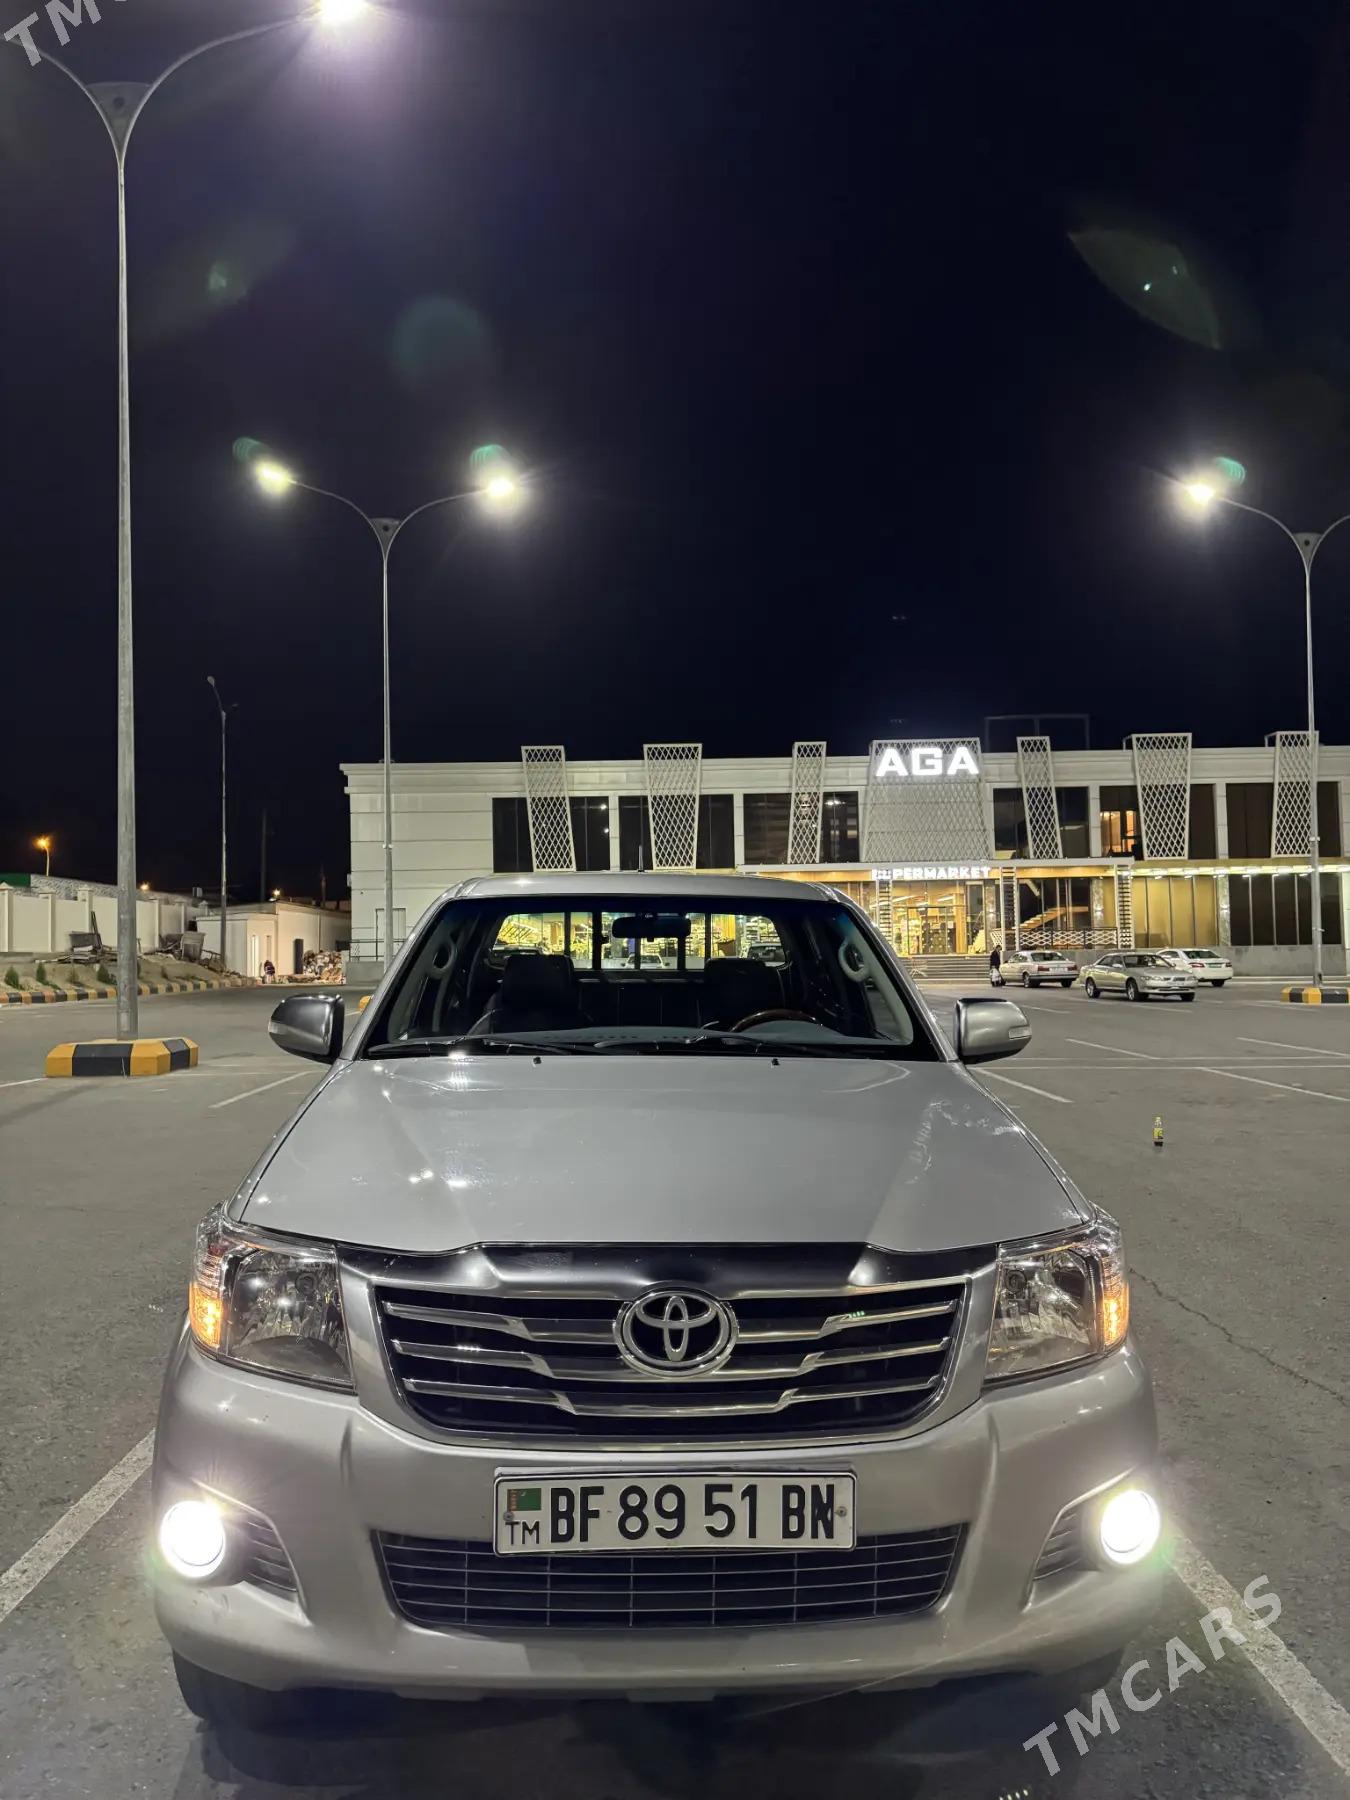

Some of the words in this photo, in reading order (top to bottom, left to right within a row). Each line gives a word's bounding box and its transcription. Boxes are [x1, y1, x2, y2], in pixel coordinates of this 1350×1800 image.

[876, 747, 980, 777] AGA
[550, 1486, 604, 1543] BF
[617, 1484, 686, 1541] 89
[704, 1484, 757, 1539] 51
[782, 1484, 835, 1539] BN
[505, 1520, 540, 1546] TM
